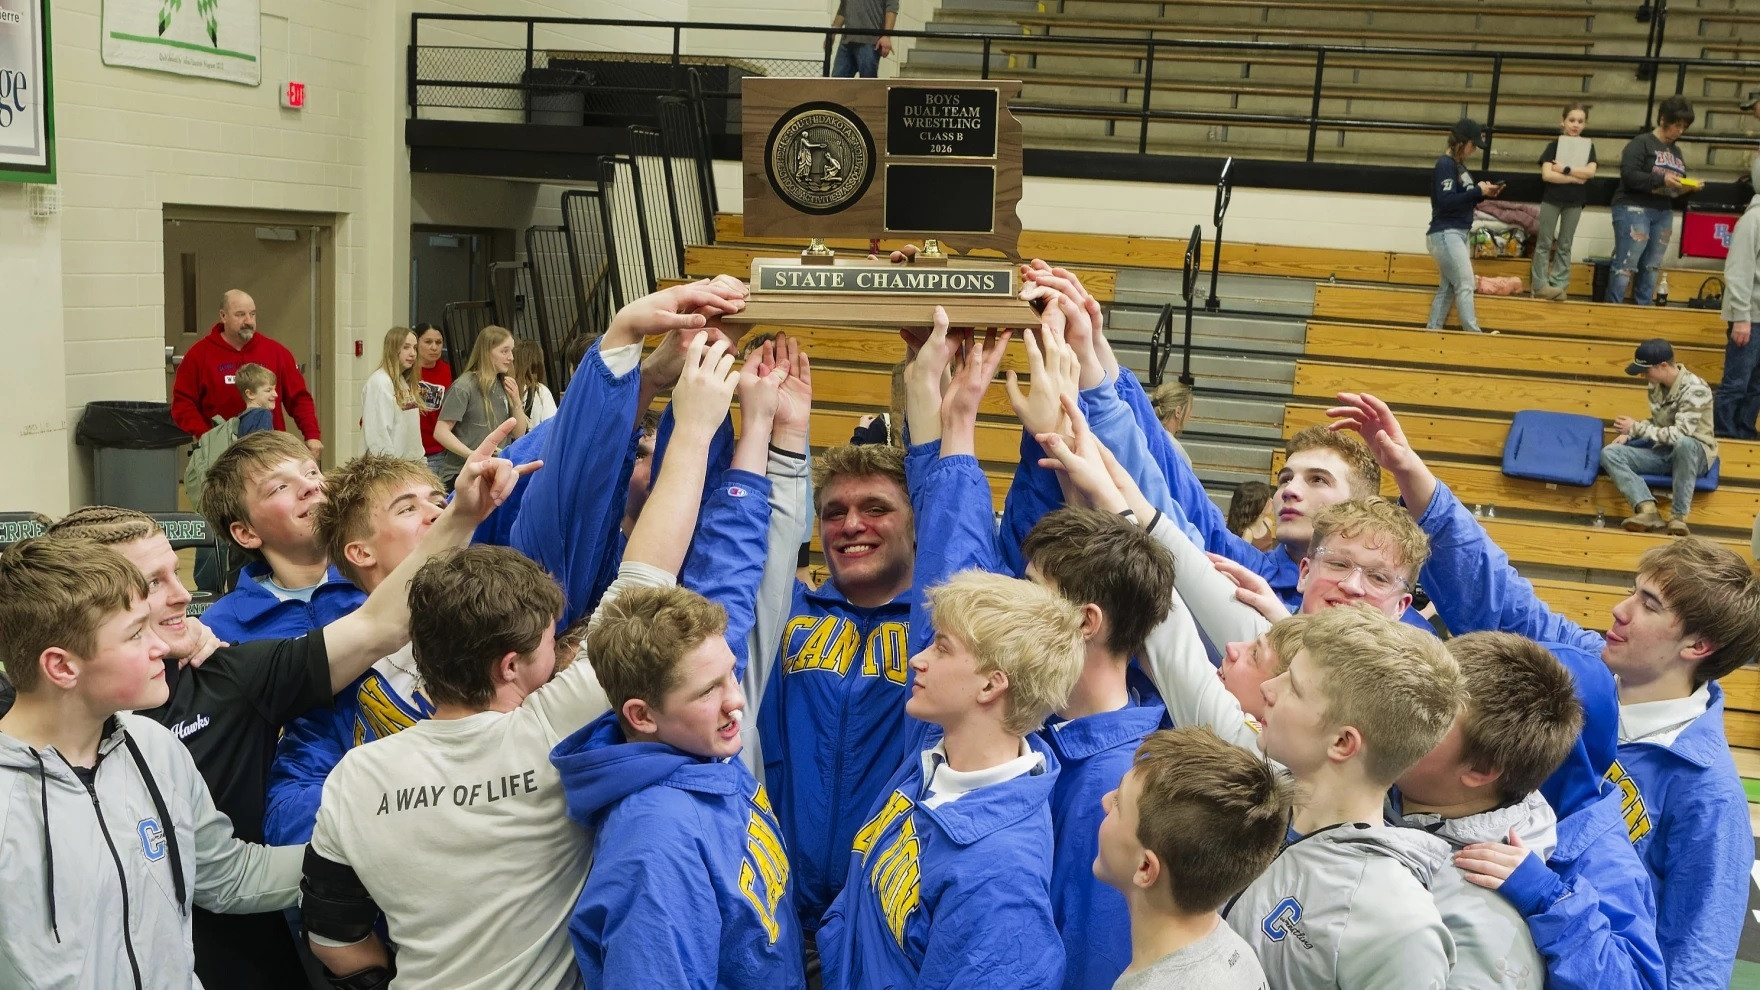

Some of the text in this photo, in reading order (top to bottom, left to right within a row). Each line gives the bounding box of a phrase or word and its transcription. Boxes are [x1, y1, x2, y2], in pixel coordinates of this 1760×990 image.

[925, 94, 960, 105] BOYS
[904, 105, 981, 117] DUAL TEAM
[786, 115, 853, 138] SOUTH DAKOTA
[903, 117, 981, 129] WRESTLING
[919, 132, 964, 141] CLASS B
[930, 144, 953, 153] 2026
[775, 271, 995, 290] STATE CHAMPIONS
[781, 614, 910, 687] CANTO
[170, 713, 210, 739] Hawks
[376, 769, 538, 815] A WAY OF LIFE
[136, 816, 166, 863] C
[1261, 895, 1304, 943] C
